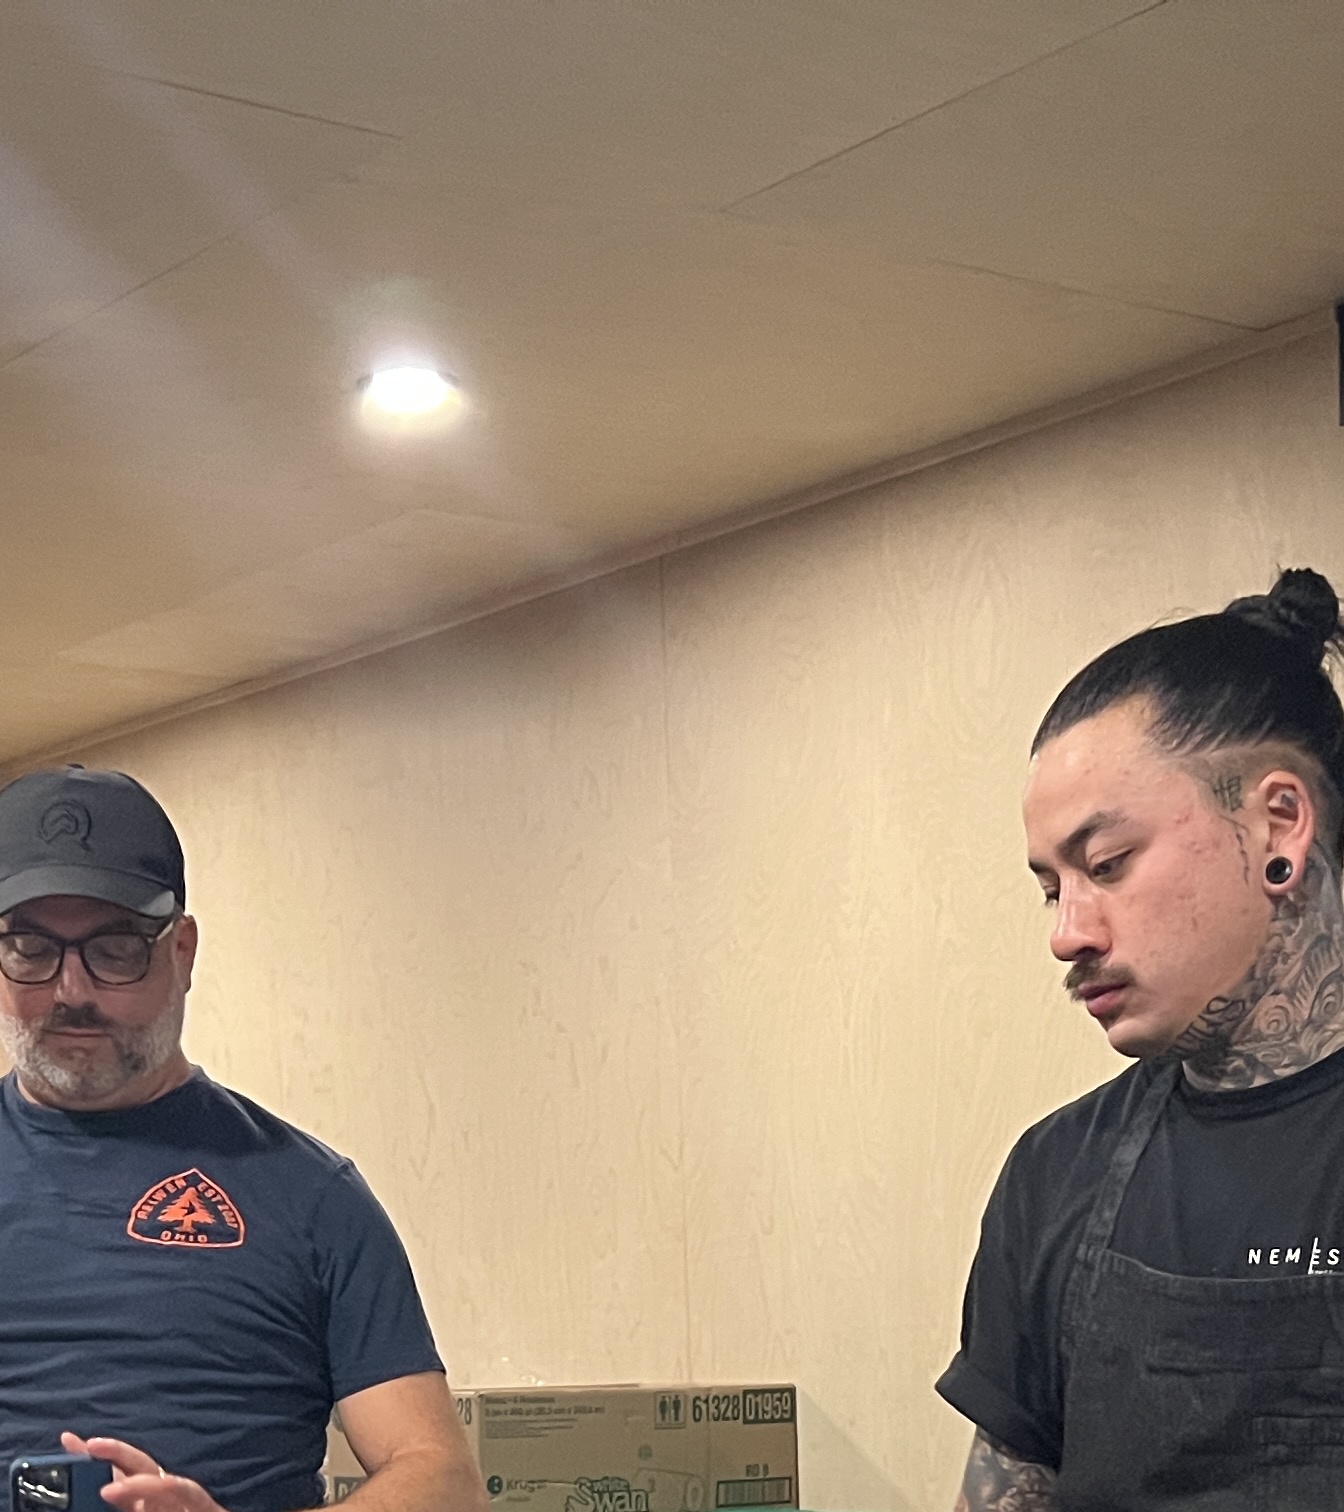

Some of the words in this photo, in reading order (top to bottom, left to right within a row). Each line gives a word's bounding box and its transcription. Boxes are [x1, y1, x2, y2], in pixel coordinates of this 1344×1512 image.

[160, 1231, 208, 1243] OHIO
[692, 1395, 741, 1423] 61328
[745, 1392, 792, 1421] 01959
